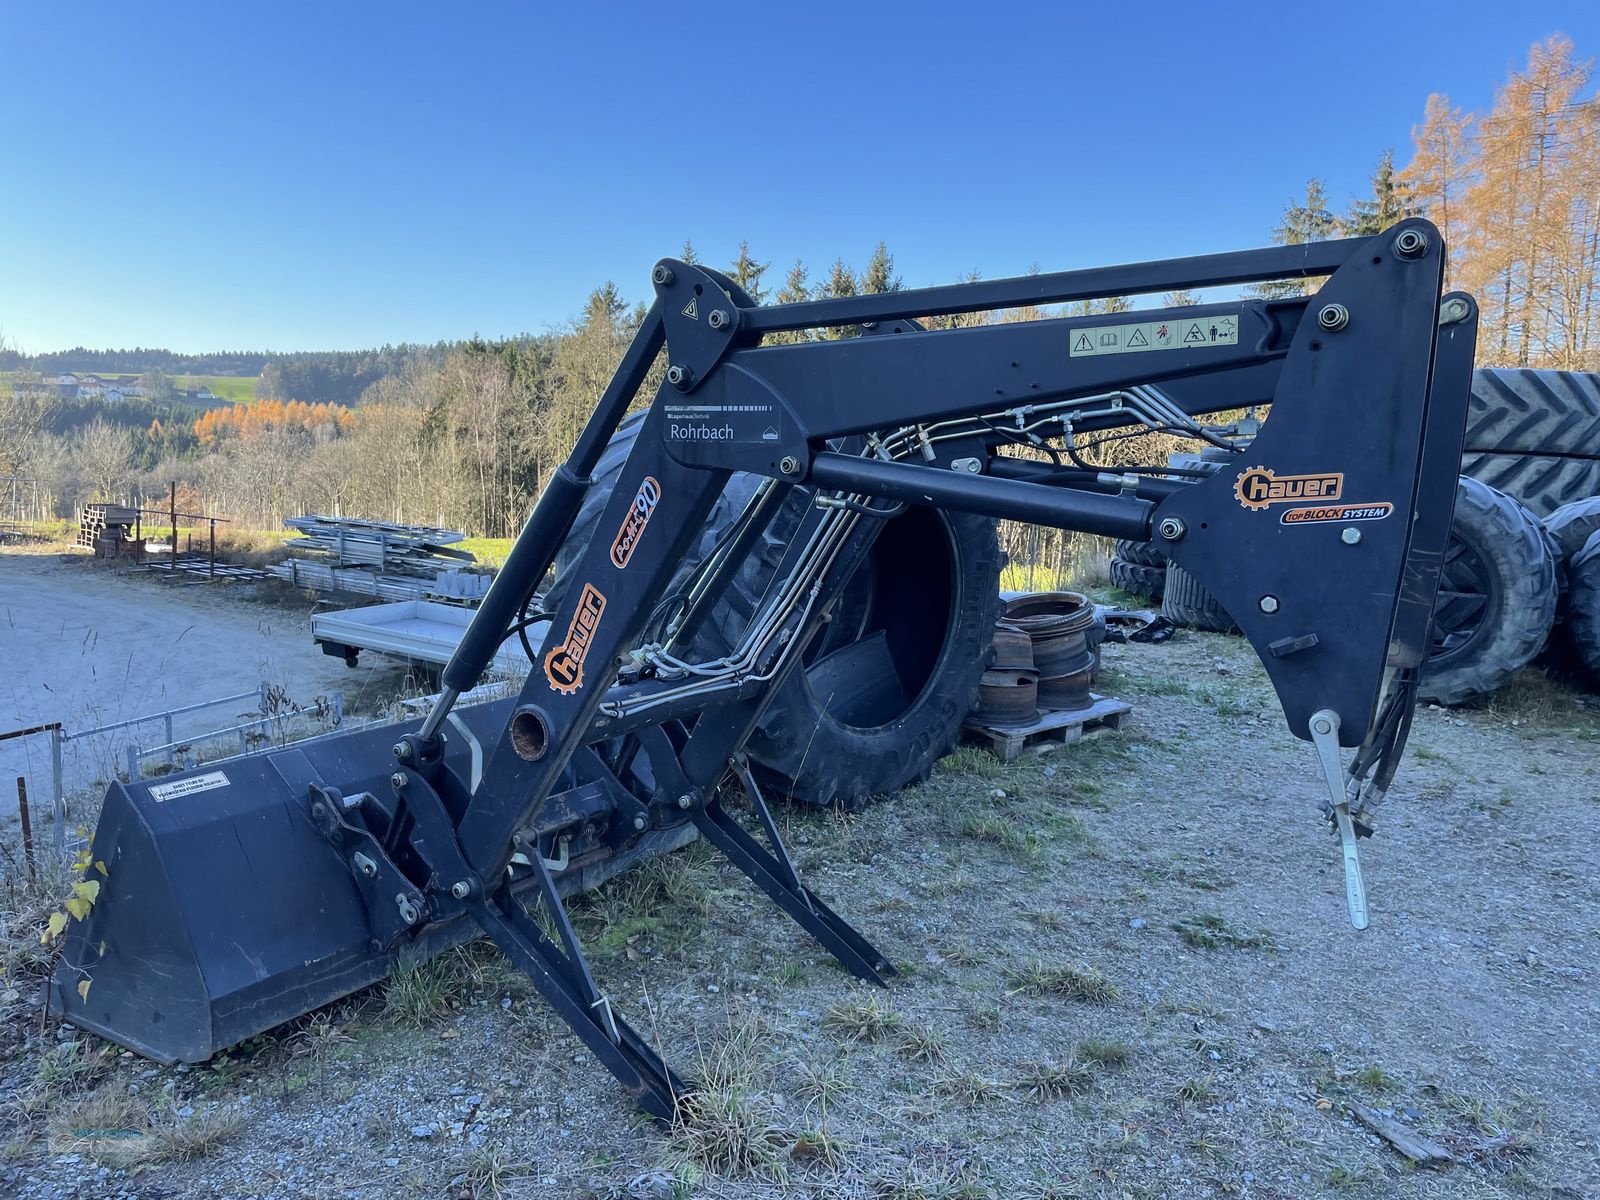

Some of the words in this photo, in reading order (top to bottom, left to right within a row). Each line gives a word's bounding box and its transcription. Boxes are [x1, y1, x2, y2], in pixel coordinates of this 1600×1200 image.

[670, 423, 734, 440] Rohrbach
[636, 480, 657, 519] 90
[1249, 476, 1337, 500] hauer
[1342, 508, 1385, 519] SYSTEM
[552, 591, 599, 682] hauer
